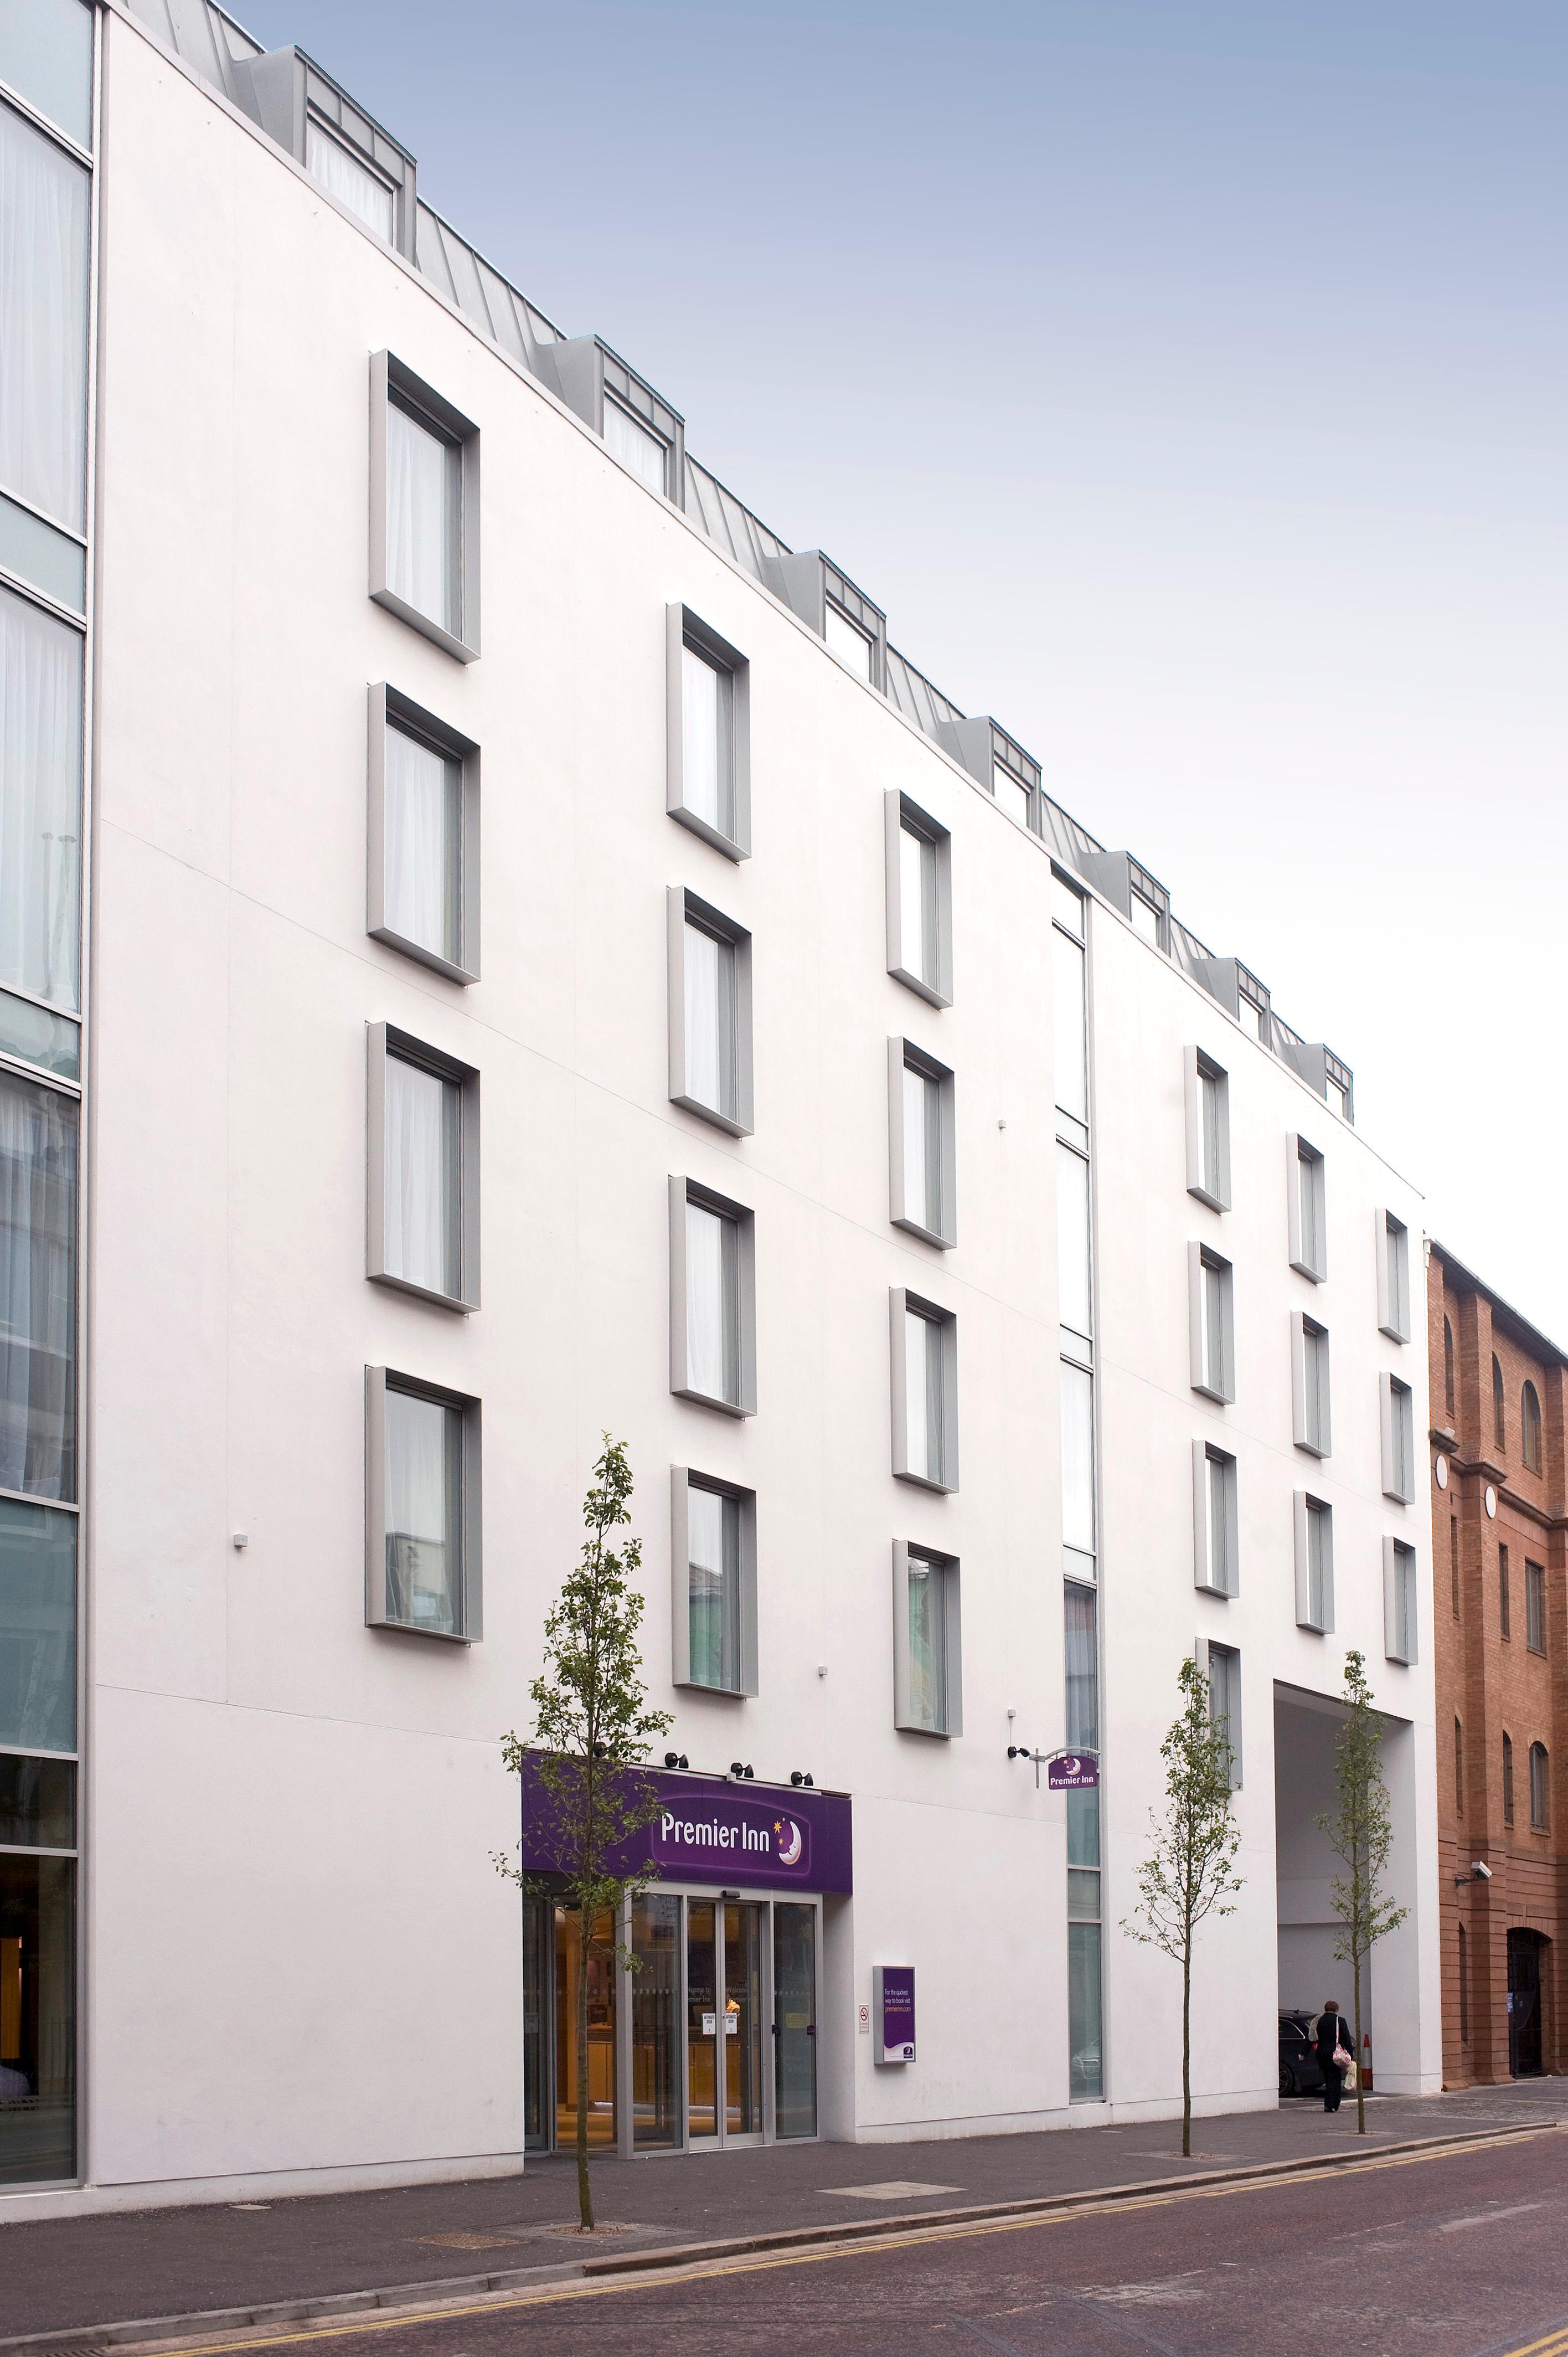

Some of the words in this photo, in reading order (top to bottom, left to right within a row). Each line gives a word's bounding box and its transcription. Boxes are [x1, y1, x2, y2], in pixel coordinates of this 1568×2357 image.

[1050, 1777, 1081, 1785] Premier
[662, 1813, 739, 1848] Premier
[742, 1821, 770, 1852] Inn
